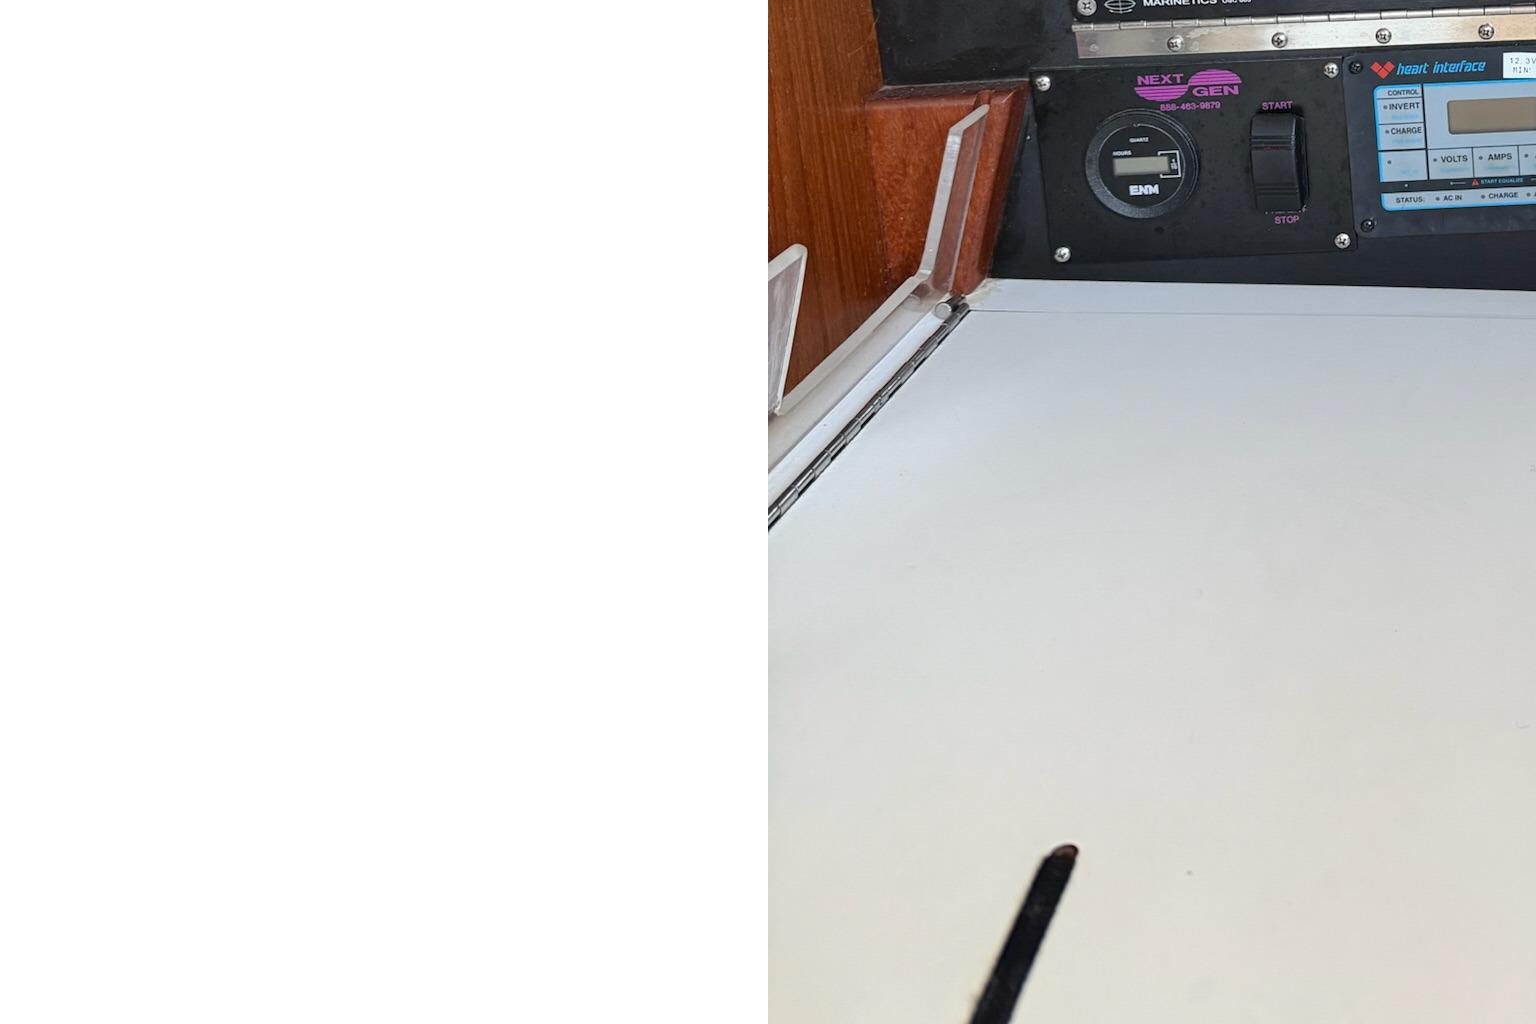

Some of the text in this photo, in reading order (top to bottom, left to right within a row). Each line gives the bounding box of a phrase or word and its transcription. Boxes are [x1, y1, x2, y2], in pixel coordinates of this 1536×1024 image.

[1396, 59, 1487, 76] heart interface
[1136, 73, 1184, 86] NEXT
[1192, 85, 1240, 97] GEN
[1387, 89, 1420, 97] CONTROL
[1262, 100, 1293, 110] START
[1389, 102, 1420, 111] INVERT
[1390, 126, 1423, 135] CHARGE
[1440, 154, 1468, 163] VOLTS
[1487, 152, 1513, 161] AMPS
[1129, 184, 1160, 196] ENM
[1488, 191, 1519, 199] CHARGE
[1395, 196, 1424, 204] STATUS
[1274, 215, 1300, 224] STOP
